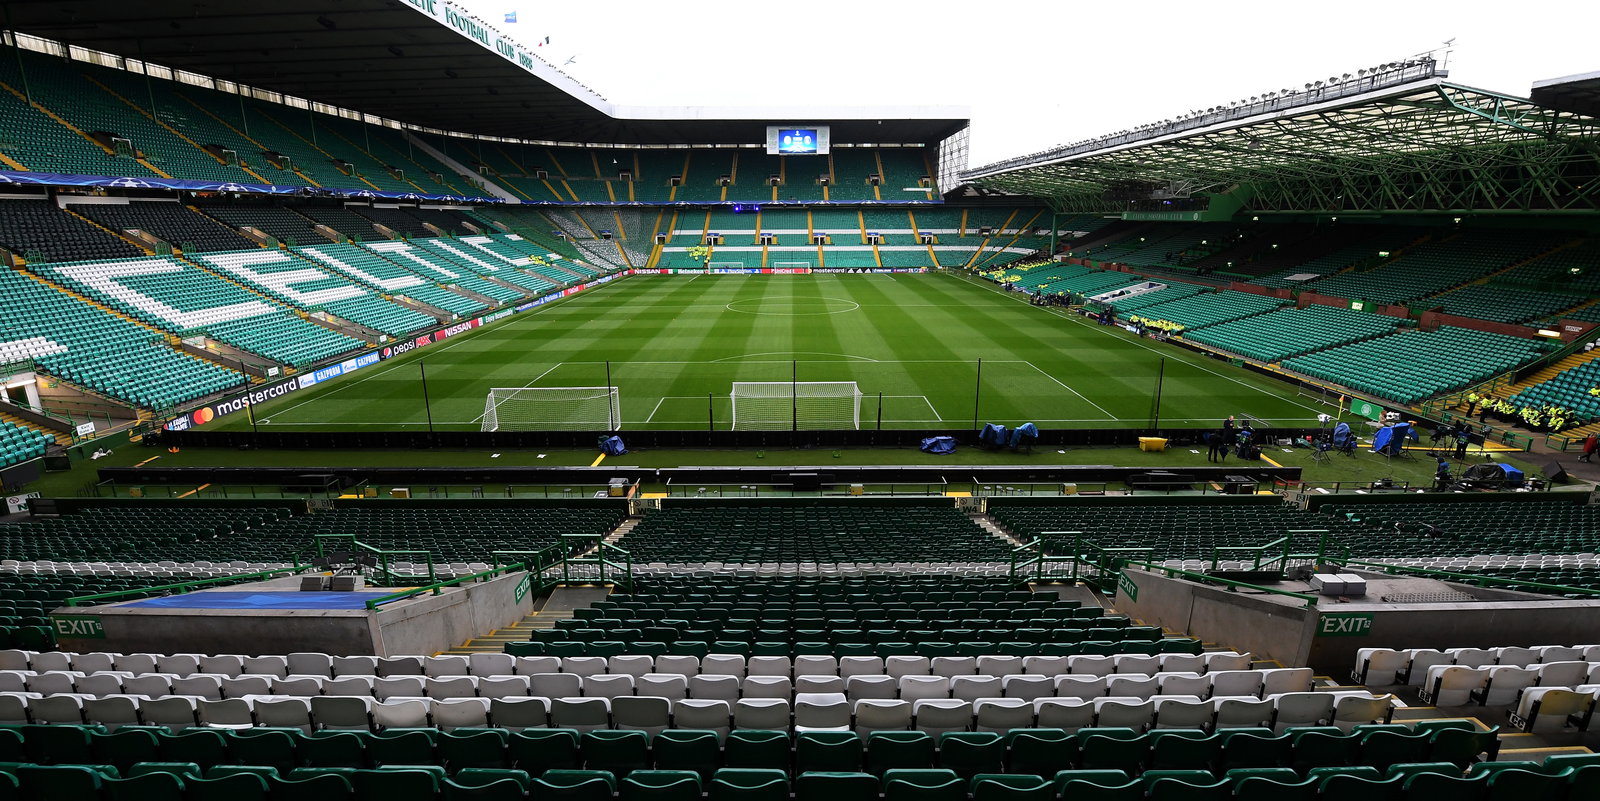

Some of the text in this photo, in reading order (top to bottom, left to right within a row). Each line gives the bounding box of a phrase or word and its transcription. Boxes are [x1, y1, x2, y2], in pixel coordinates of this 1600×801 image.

[445, 6, 490, 46] FOOTBALL
[496, 38, 515, 60] CLUB
[518, 51, 533, 71] 1888
[444, 321, 472, 337] NISSAN
[393, 334, 432, 356] pepsi MAX
[357, 353, 379, 367] GAZPROM
[316, 365, 341, 381] GAZPROM
[217, 379, 297, 416] mastercard
[516, 576, 528, 600] EXIT
[1120, 574, 1136, 596] EXIT
[55, 620, 95, 634] EXIT
[1323, 617, 1367, 632] EXIT
[1512, 714, 1525, 729] CC
